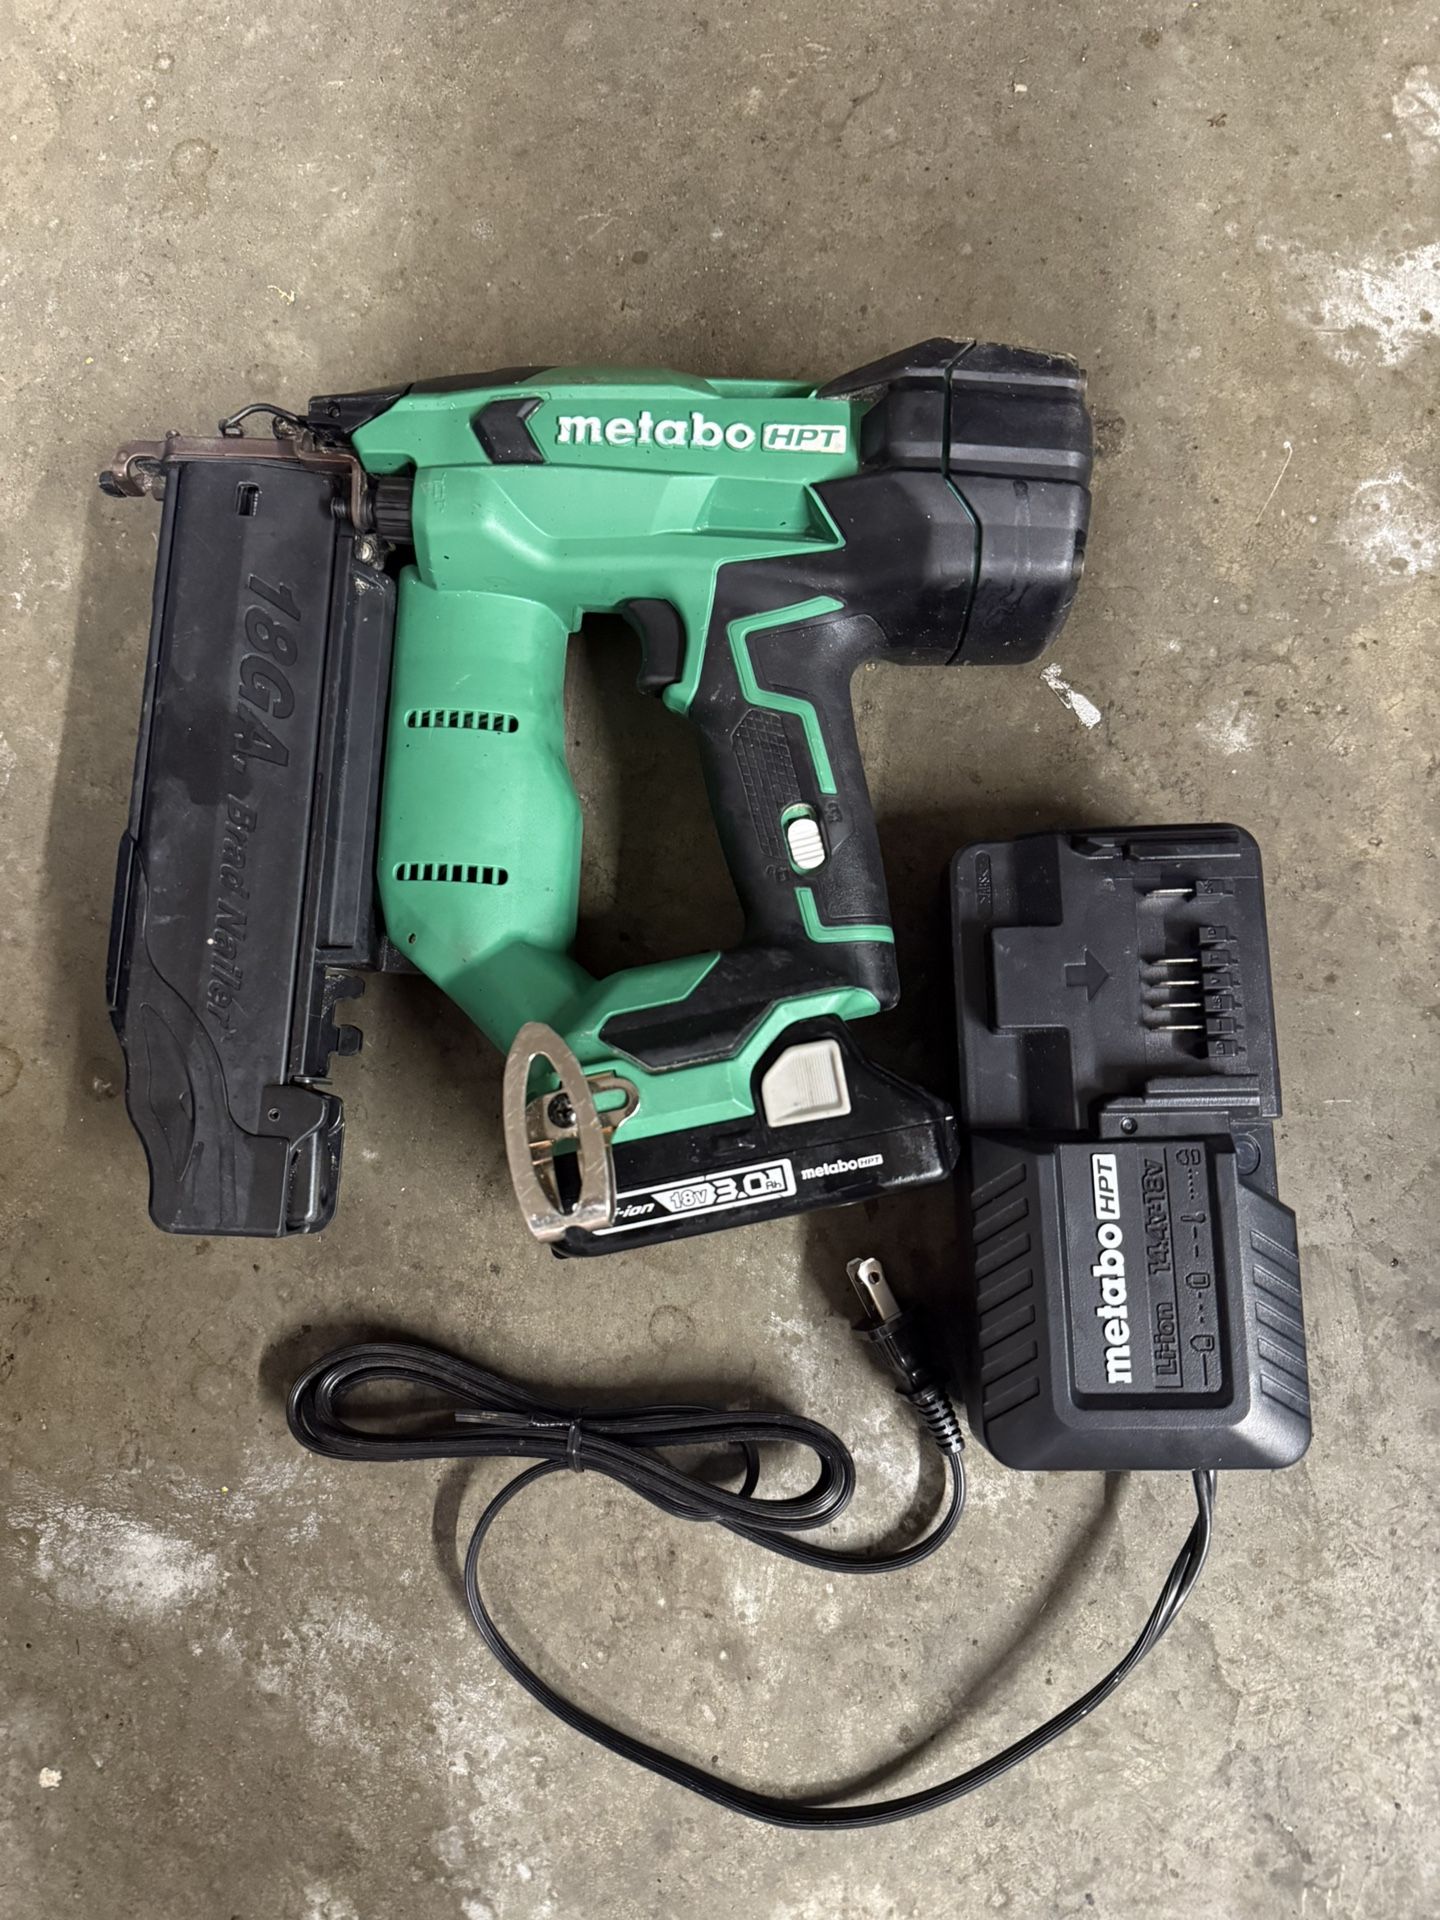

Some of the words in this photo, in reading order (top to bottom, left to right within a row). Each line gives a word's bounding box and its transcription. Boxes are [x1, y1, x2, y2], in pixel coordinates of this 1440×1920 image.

[557, 411, 755, 449] metabo
[766, 426, 842, 450] HPT
[219, 793, 257, 899] Brad
[207, 897, 248, 1029] Nailer
[801, 1158, 858, 1180] metabo
[859, 1155, 882, 1168] HPT
[1095, 1157, 1118, 1216] HPT
[1093, 1223, 1132, 1383] metabo
[1154, 1302, 1178, 1375] Li-ion
